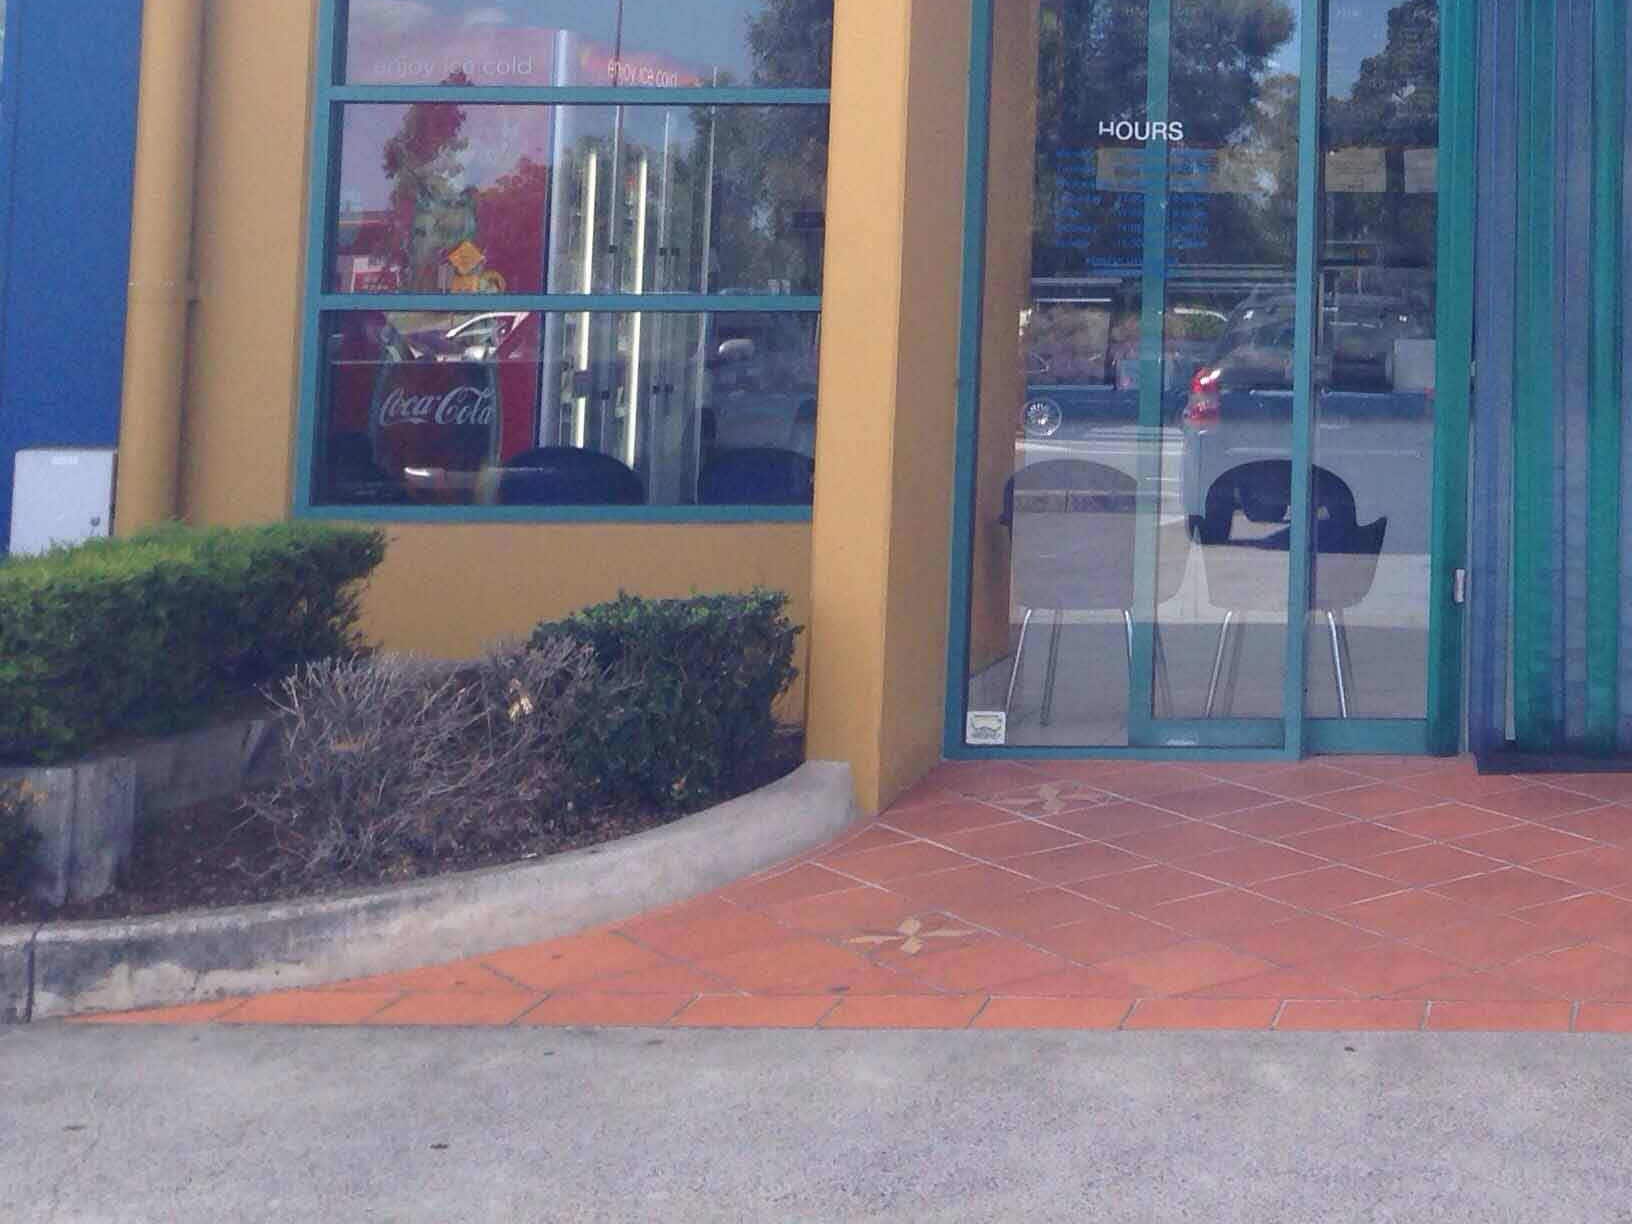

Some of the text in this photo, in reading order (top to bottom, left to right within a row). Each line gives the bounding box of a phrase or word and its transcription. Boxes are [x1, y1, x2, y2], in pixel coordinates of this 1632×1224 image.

[482, 56, 533, 75] cold
[1099, 121, 1183, 141] HOURS
[379, 385, 494, 426] Coca-Cola
